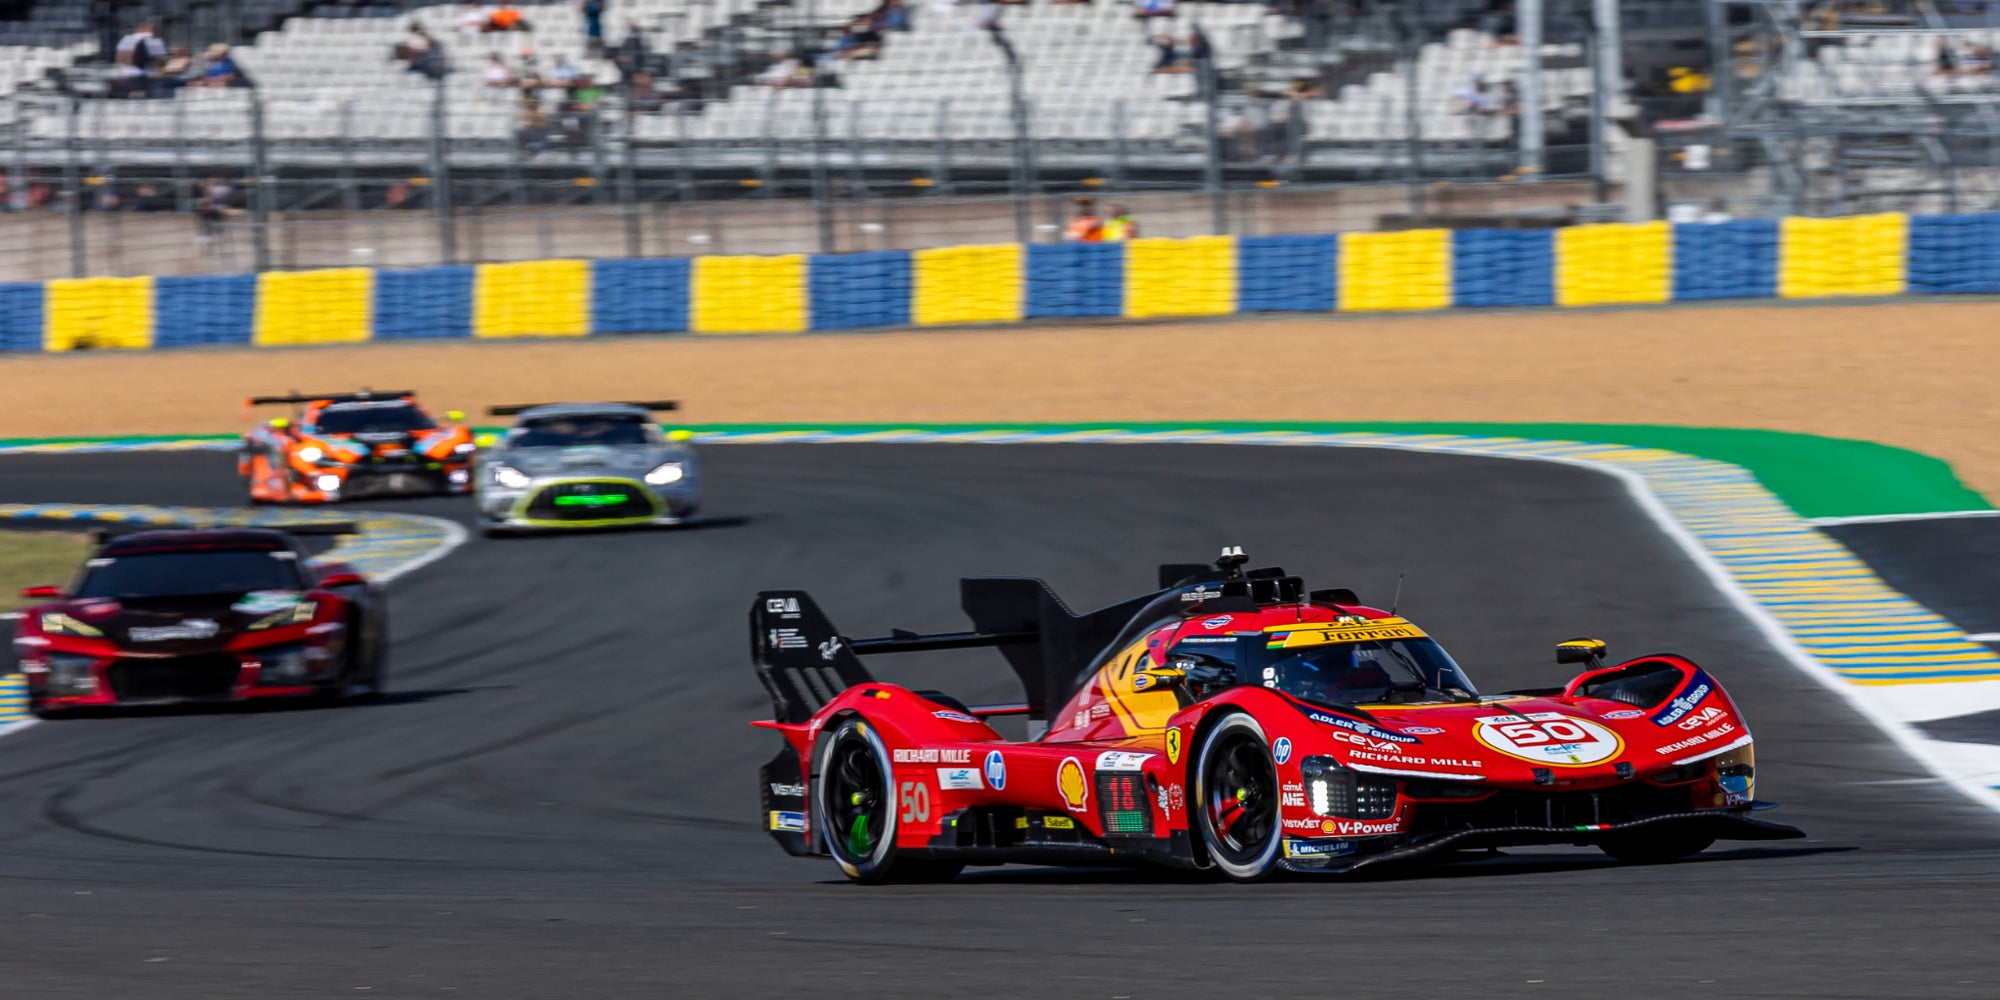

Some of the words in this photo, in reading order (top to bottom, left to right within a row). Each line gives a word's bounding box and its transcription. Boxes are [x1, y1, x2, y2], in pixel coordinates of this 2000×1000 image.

[1321, 624, 1416, 642] Ferrari
[1309, 712, 1353, 729] ADLER
[1371, 729, 1416, 743] GROUP
[1500, 721, 1587, 744] 50
[1655, 735, 1707, 755] RICHARD
[1703, 722, 1735, 740] MILLE
[893, 749, 939, 763] RICHARD
[940, 749, 972, 764] MILLE
[1349, 749, 1426, 765] RICHARD
[1431, 758, 1482, 768] MILLE
[901, 781, 930, 823] 50
[1282, 792, 1306, 807] AHE
[1337, 822, 1400, 835] V-Power
[1300, 842, 1349, 853] MICHELIN
